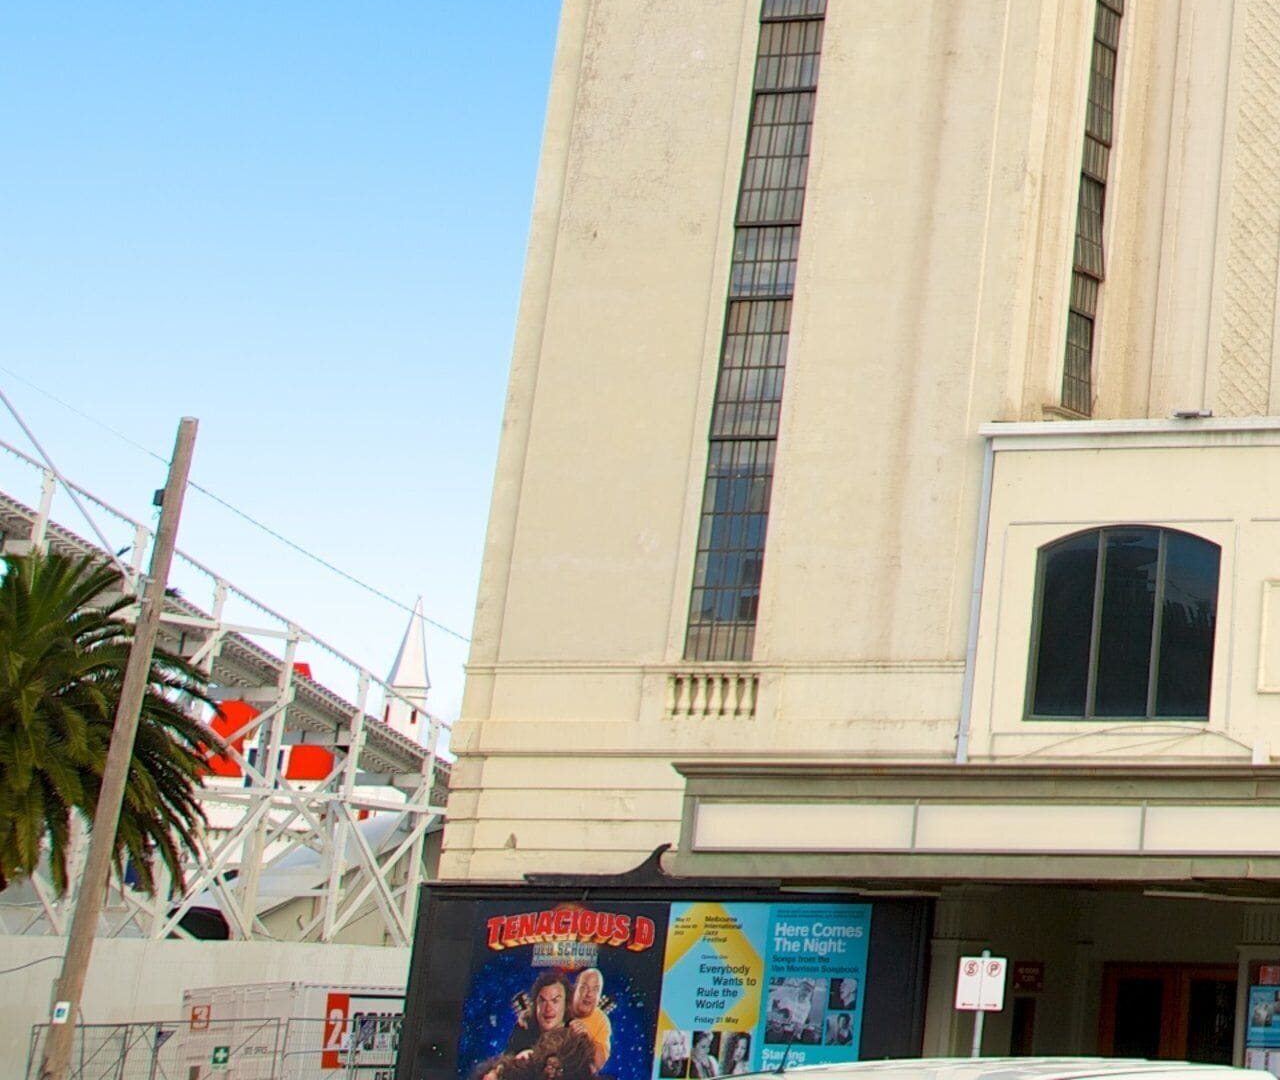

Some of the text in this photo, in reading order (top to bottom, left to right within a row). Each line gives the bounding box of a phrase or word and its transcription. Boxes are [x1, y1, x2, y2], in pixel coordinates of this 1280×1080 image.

[487, 909, 632, 948] TENACIOUS
[629, 915, 657, 951] D
[774, 922, 863, 938] Here Comes
[773, 937, 847, 956] The Night:
[772, 954, 797, 964] Songs
[798, 955, 817, 963] from
[699, 964, 751, 976] Everybody
[712, 976, 757, 986] Wants to
[697, 987, 738, 998] Rule the
[695, 999, 726, 1010] World
[326, 1008, 345, 1050] 2
